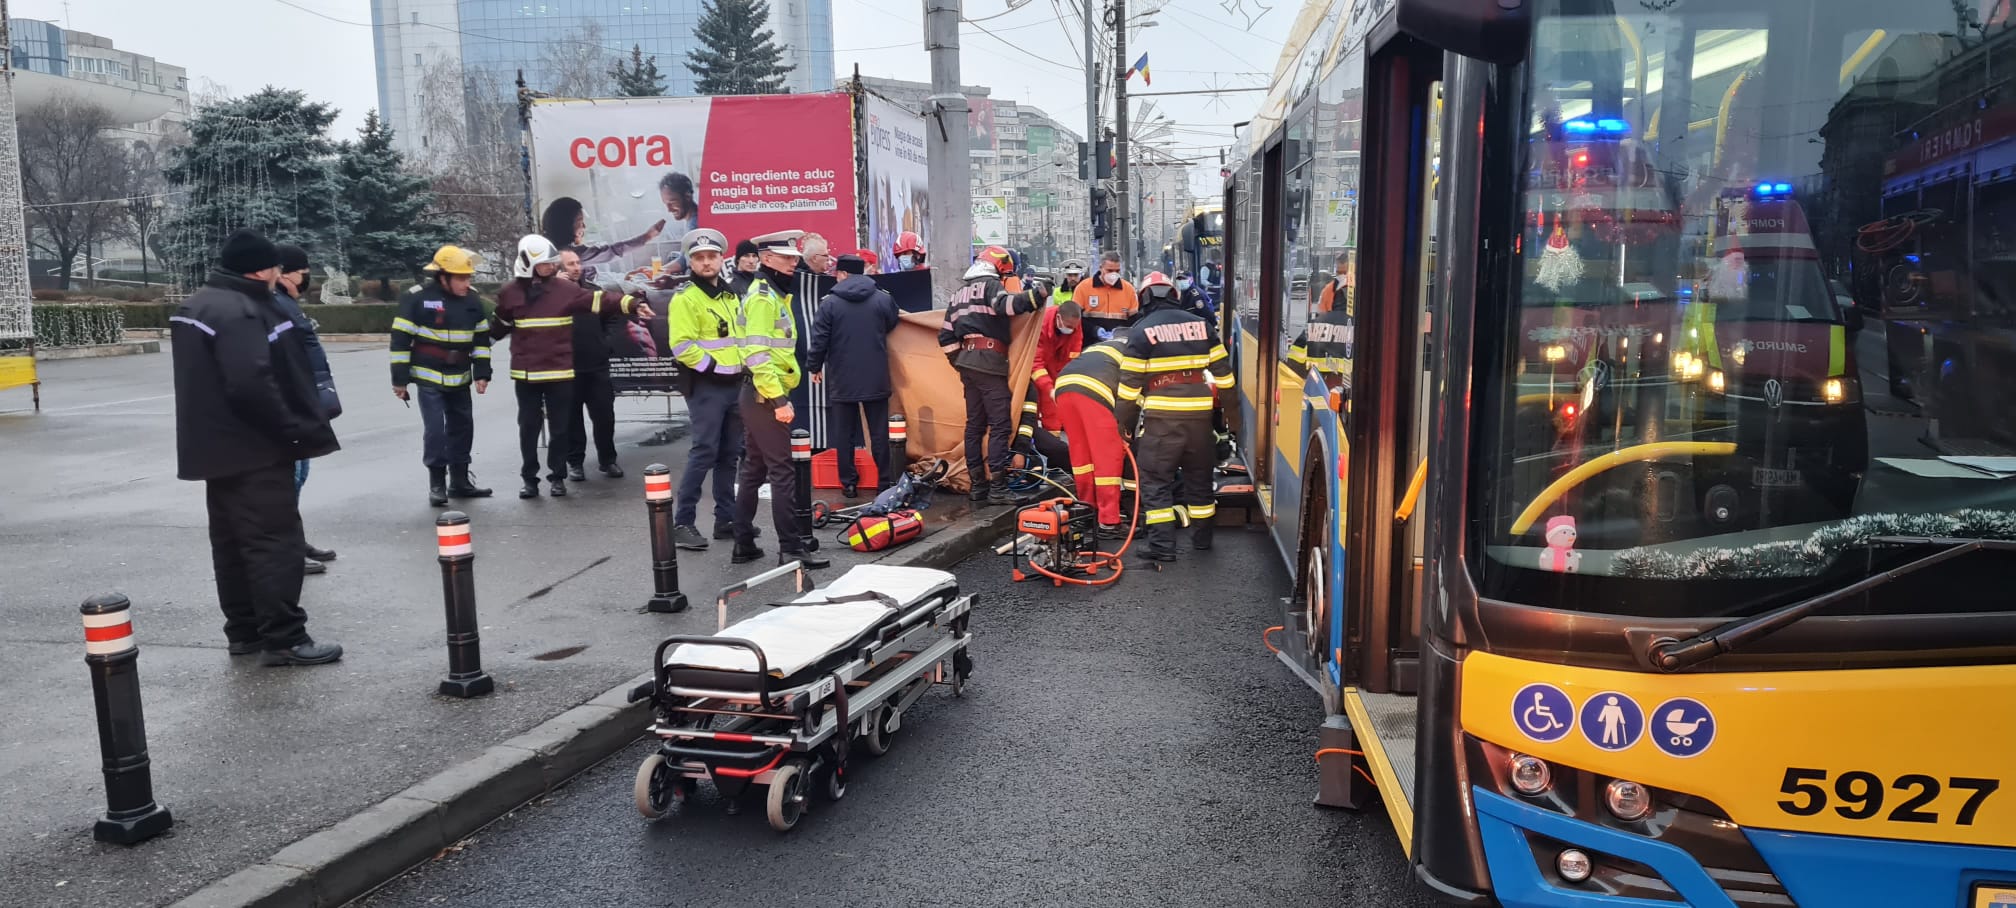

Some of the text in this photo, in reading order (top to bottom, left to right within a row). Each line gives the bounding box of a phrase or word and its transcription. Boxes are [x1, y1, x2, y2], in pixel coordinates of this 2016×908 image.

[569, 134, 673, 169] cora
[710, 168, 835, 184] Ce ingrediente aduc
[711, 182, 835, 199] magia la tine acasă?
[1144, 320, 1209, 345] POMPIERI
[1022, 521, 1050, 531] holmatro
[1776, 767, 2000, 826] 5927
